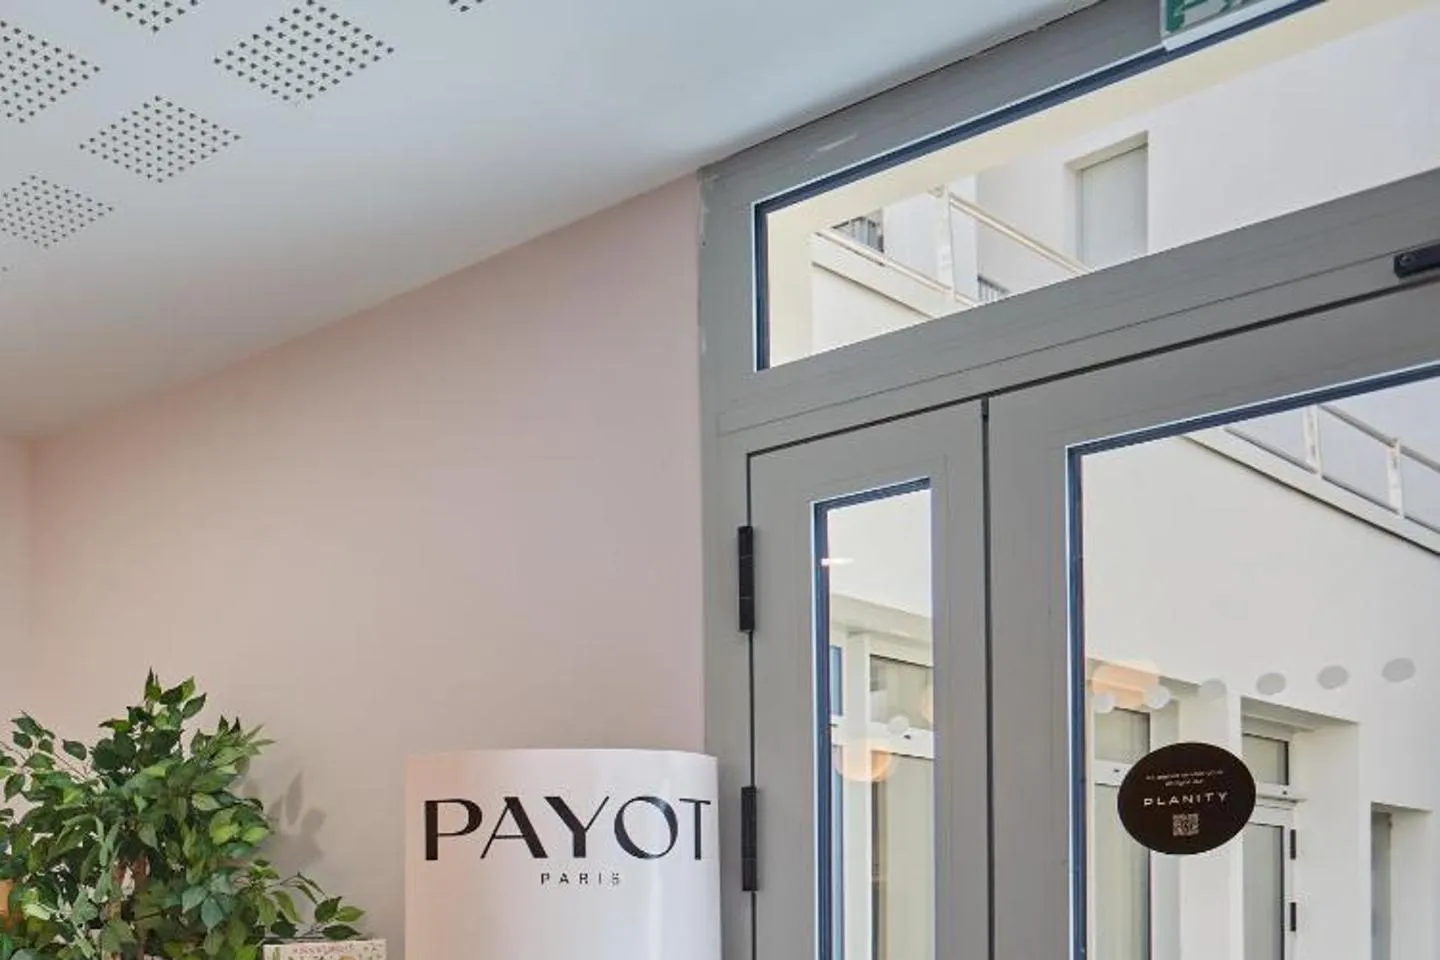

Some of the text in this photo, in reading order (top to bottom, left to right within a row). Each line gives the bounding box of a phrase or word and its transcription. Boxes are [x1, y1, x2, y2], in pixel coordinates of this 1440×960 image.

[1143, 791, 1228, 807] PLANITY
[425, 795, 711, 861] PAYOT
[541, 872, 620, 885] PARIS
